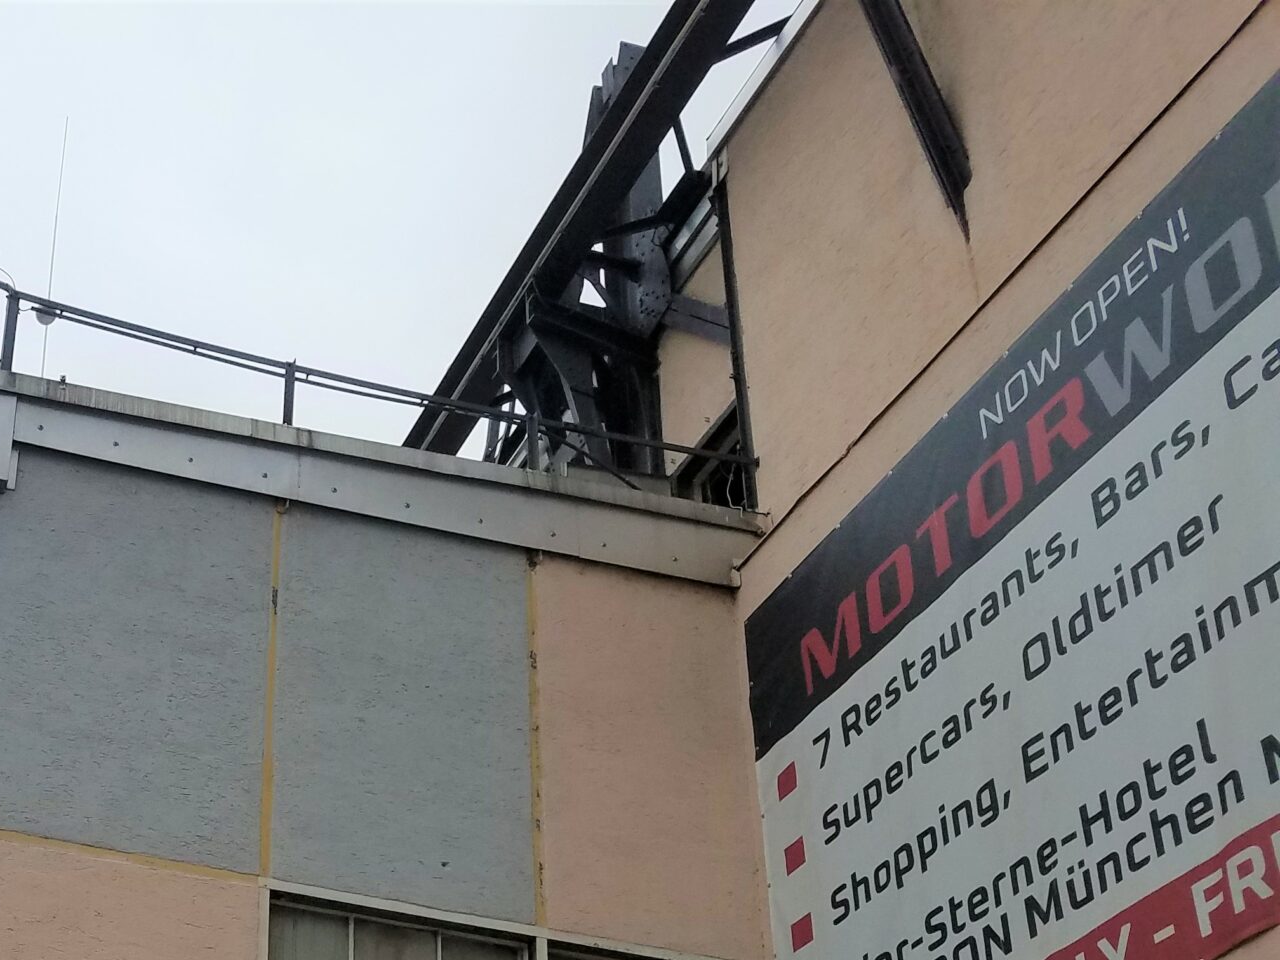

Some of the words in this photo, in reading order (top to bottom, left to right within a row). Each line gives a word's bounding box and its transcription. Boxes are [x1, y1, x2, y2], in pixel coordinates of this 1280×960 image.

[979, 330, 1062, 439] NOW
[1070, 206, 1191, 347] OPEN!
[812, 728, 832, 770] 7
[840, 531, 1080, 748] Restaurants,
[1090, 419, 1211, 530] Bars,
[822, 682, 1012, 845] Supercars,
[1022, 493, 1224, 682] Oldtimer
[831, 778, 1012, 926] Shopping,
[1024, 769, 1246, 940] München
